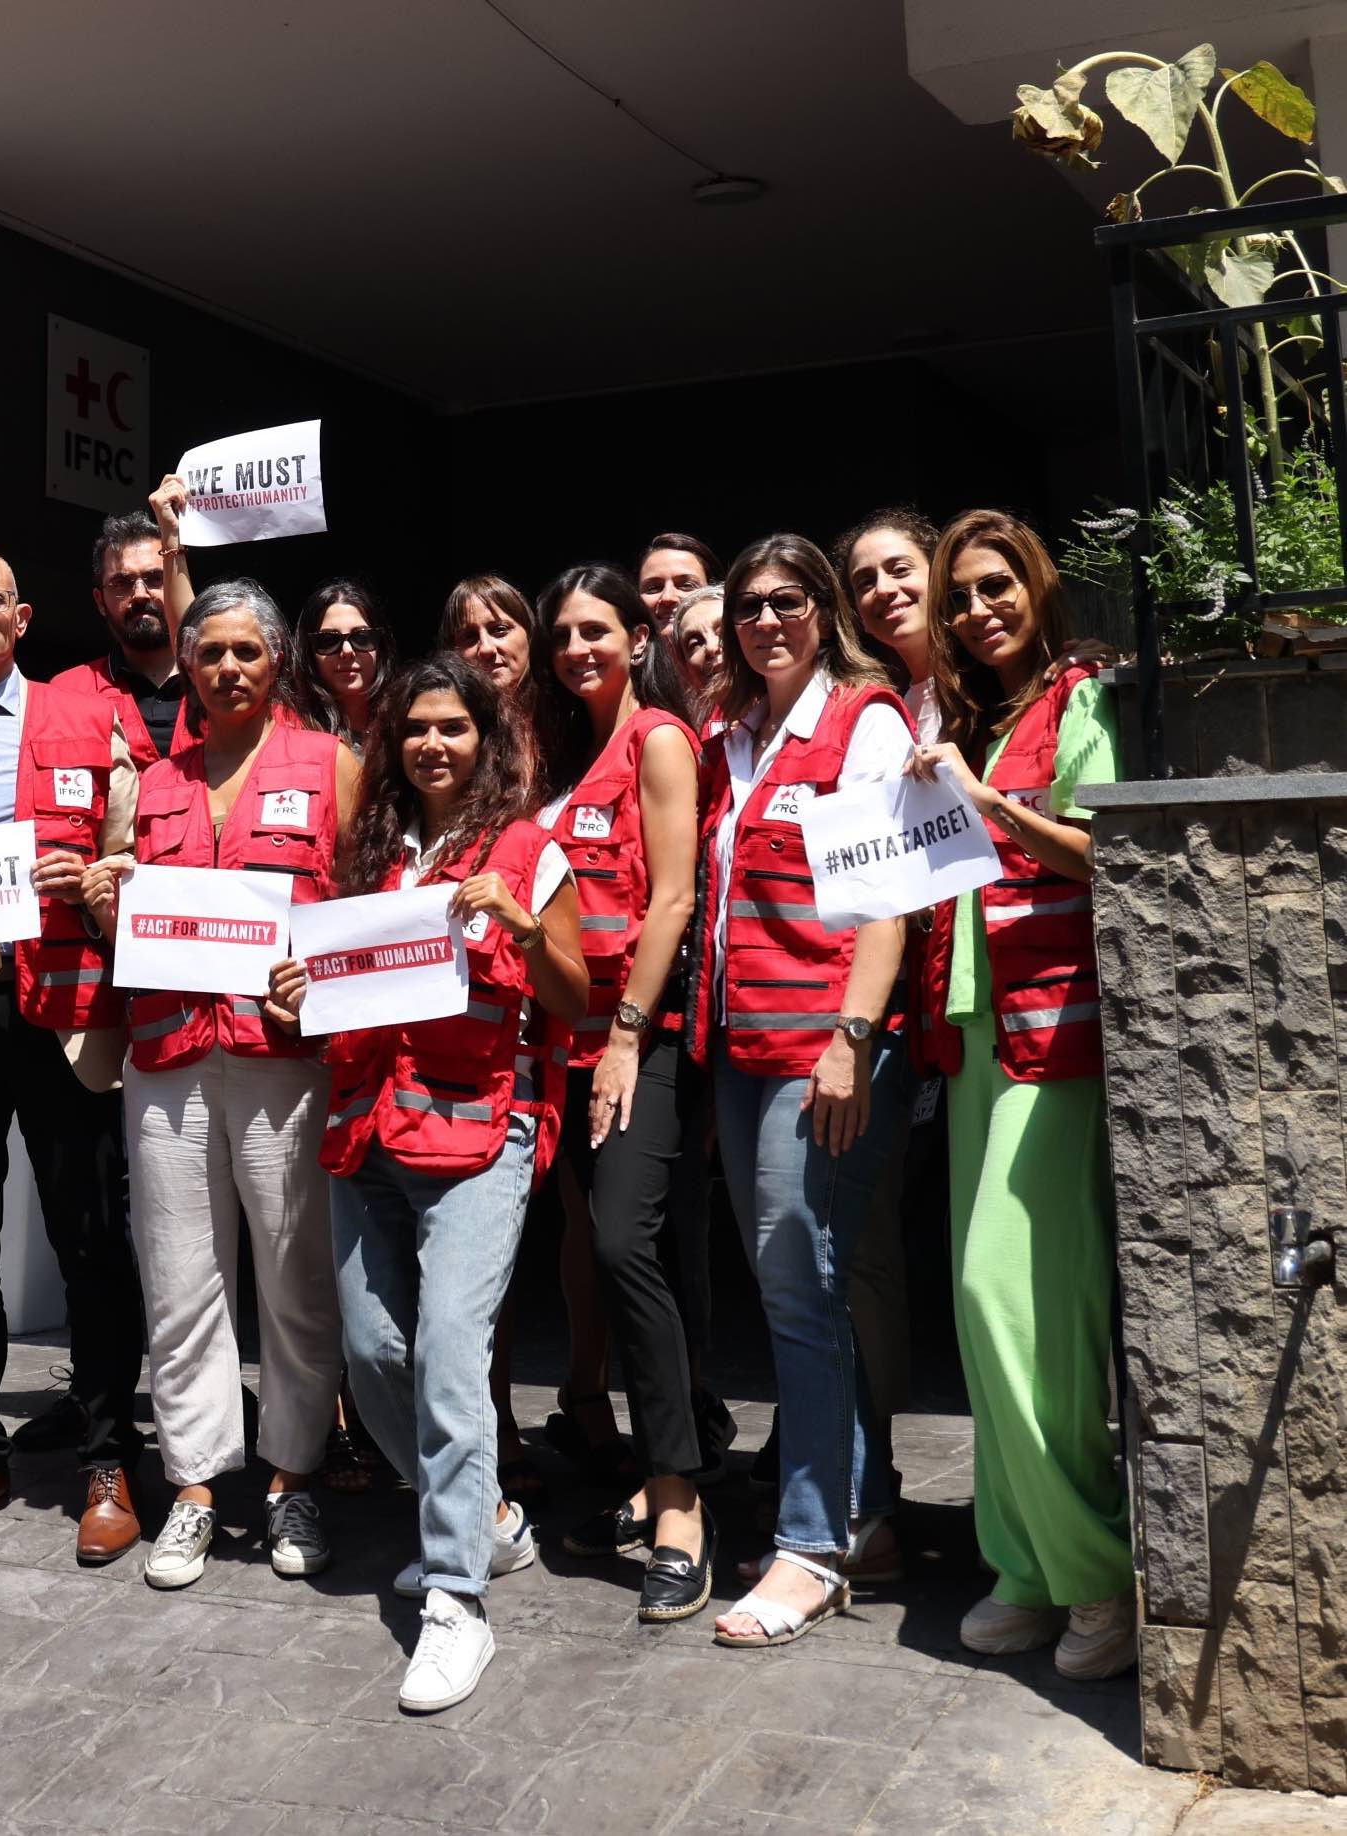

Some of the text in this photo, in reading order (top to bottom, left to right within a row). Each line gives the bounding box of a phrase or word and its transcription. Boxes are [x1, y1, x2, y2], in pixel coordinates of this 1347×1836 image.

[65, 430, 135, 486] IFRC
[188, 455, 306, 496] WE MUST
[188, 486, 307, 512] #PROTECTHUMANITY
[58, 786, 85, 798] IFRC
[273, 806, 298, 815] IFRC
[824, 803, 971, 875] #NOTATARGET
[136, 918, 271, 941] #ACTFORHUMANITY
[312, 941, 446, 976] #ACTFORHUMANITY
